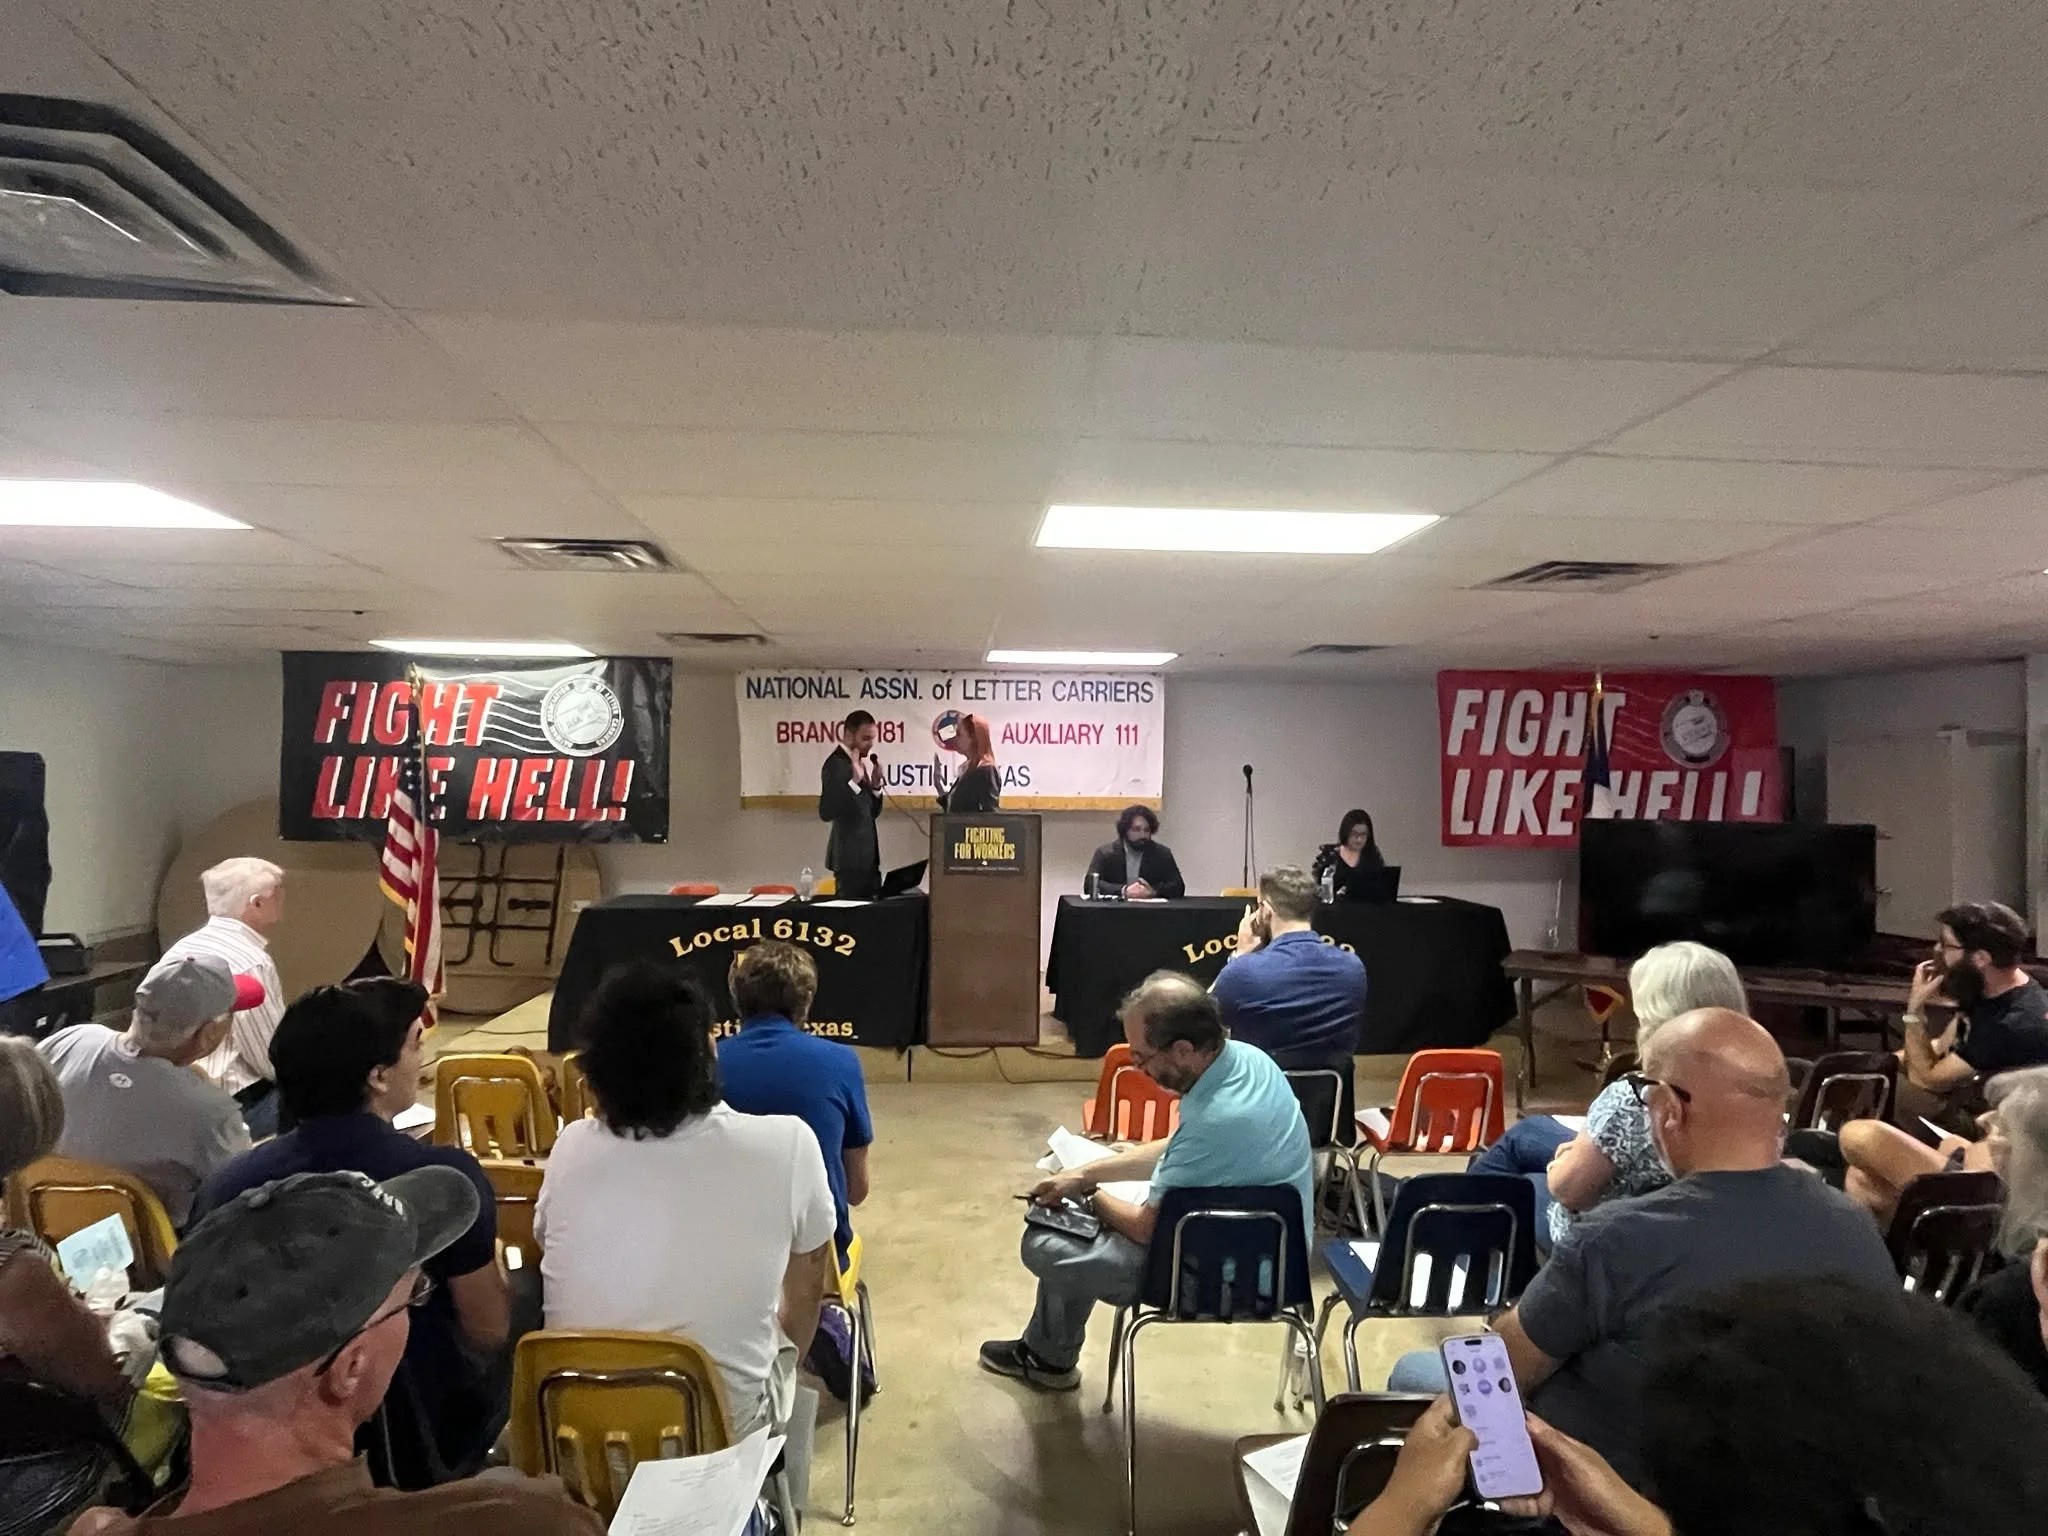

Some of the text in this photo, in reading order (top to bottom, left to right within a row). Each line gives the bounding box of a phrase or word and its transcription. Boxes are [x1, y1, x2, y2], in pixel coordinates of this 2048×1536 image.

[746, 677, 1154, 703] NATIONAL ASSN. of LETTER CARRIERS
[313, 680, 504, 747] FIGHT
[1446, 689, 1626, 757] FIGHT
[776, 720, 904, 743] BRANC 181
[1001, 722, 1139, 745] AUXILIARY 111
[465, 757, 635, 821] HELL!
[1450, 768, 1583, 836] LIKE
[965, 827, 1005, 844] FIGHTING
[954, 843, 1016, 860] FOR WORKERS
[668, 918, 857, 958] Local 6132
[1182, 934, 1238, 964] Loc
